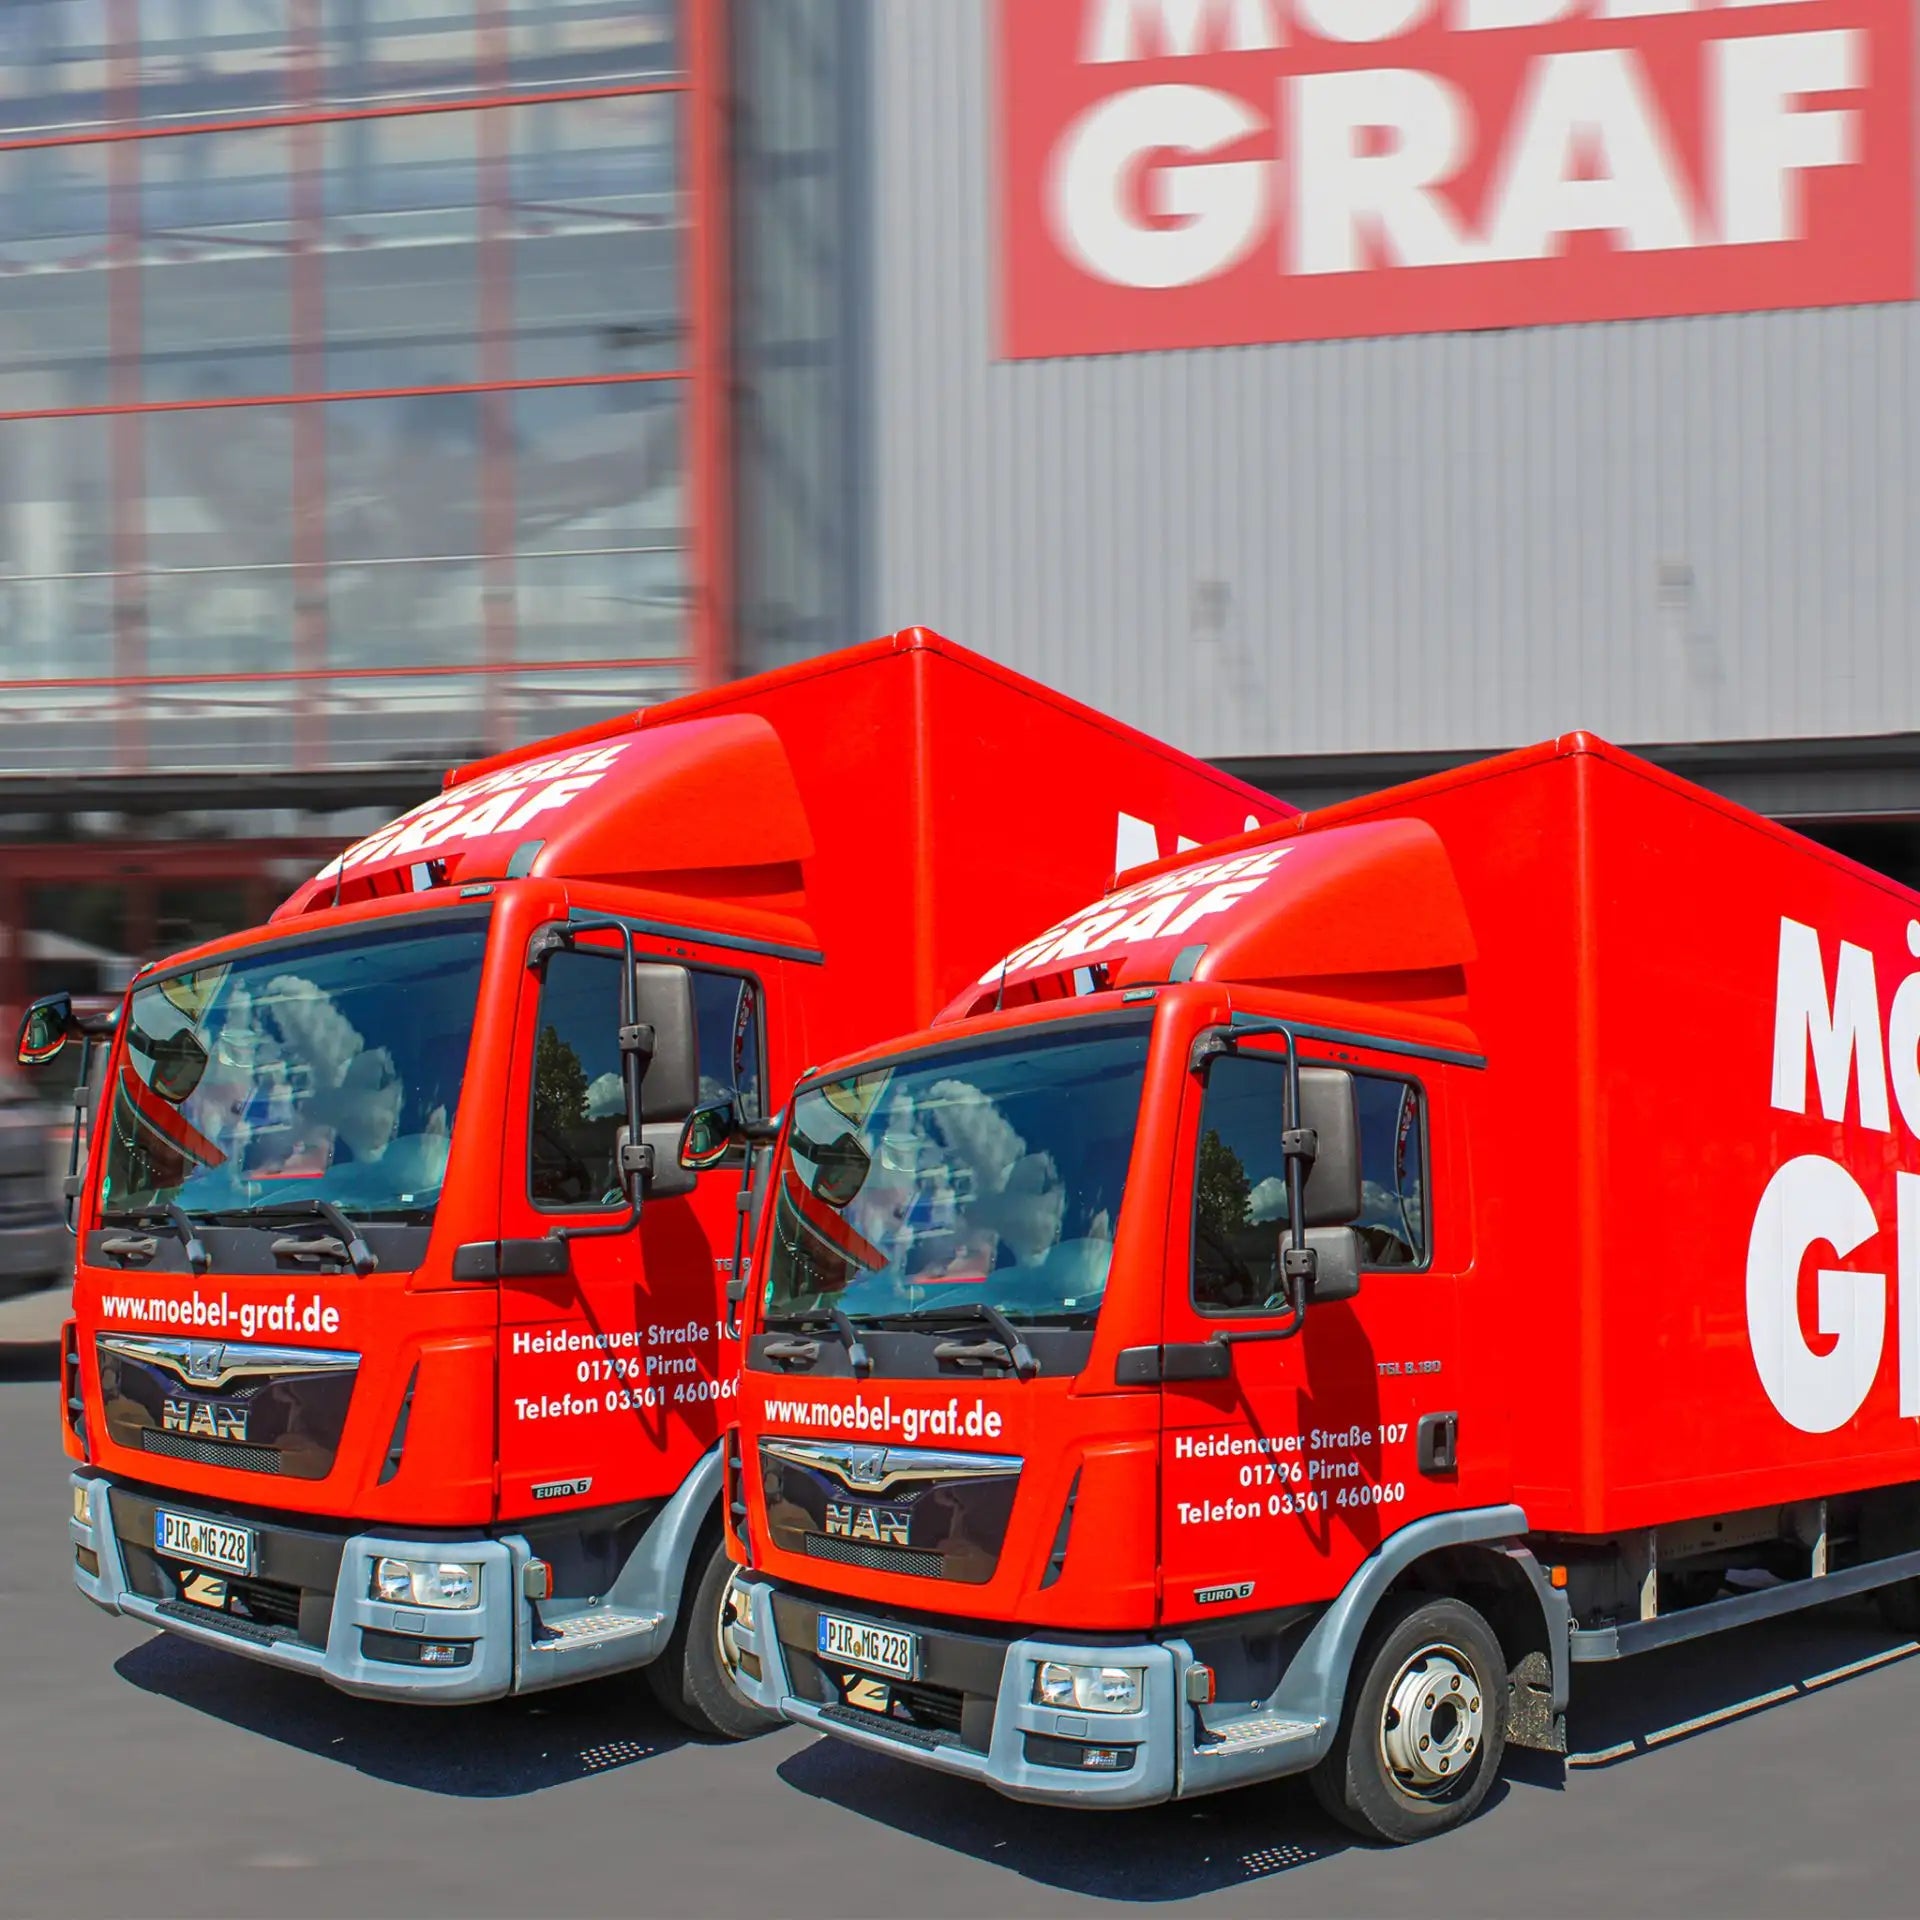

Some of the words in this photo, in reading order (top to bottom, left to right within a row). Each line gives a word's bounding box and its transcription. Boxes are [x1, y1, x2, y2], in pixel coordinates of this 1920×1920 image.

[1042, 28, 1868, 288] GRAF
[315, 773, 606, 881] GRAF
[977, 877, 1269, 985] GRAF
[102, 1290, 341, 1337] www.moebel-graf.de
[514, 1329, 642, 1353] Heidenauer
[649, 1321, 709, 1344] Straße
[578, 1357, 640, 1381] 01796
[647, 1354, 696, 1375] Pirna
[163, 1398, 249, 1441] MAN
[515, 1393, 599, 1419] Telefon
[606, 1386, 665, 1410] 03501
[764, 1395, 1003, 1442] www.moebel-graf.de
[1176, 1434, 1304, 1458] Heidenauer
[1311, 1426, 1371, 1449] Straße
[1378, 1424, 1408, 1444] 107
[537, 1484, 571, 1498] EURO
[578, 1479, 588, 1492] 6
[1240, 1462, 1302, 1486] 01796
[1309, 1459, 1358, 1480] Pirna
[825, 1503, 911, 1546] MAN
[1177, 1498, 1261, 1524] Telefon
[1268, 1491, 1327, 1515] 03501
[1336, 1482, 1404, 1507] 460060
[166, 1517, 191, 1549] PIR
[200, 1524, 217, 1555] MG
[220, 1529, 246, 1563] 228
[1199, 1589, 1233, 1603] EURO
[1240, 1584, 1250, 1597] 6
[828, 1622, 853, 1654] PIR
[862, 1629, 879, 1660] MG
[882, 1634, 908, 1668] 228
